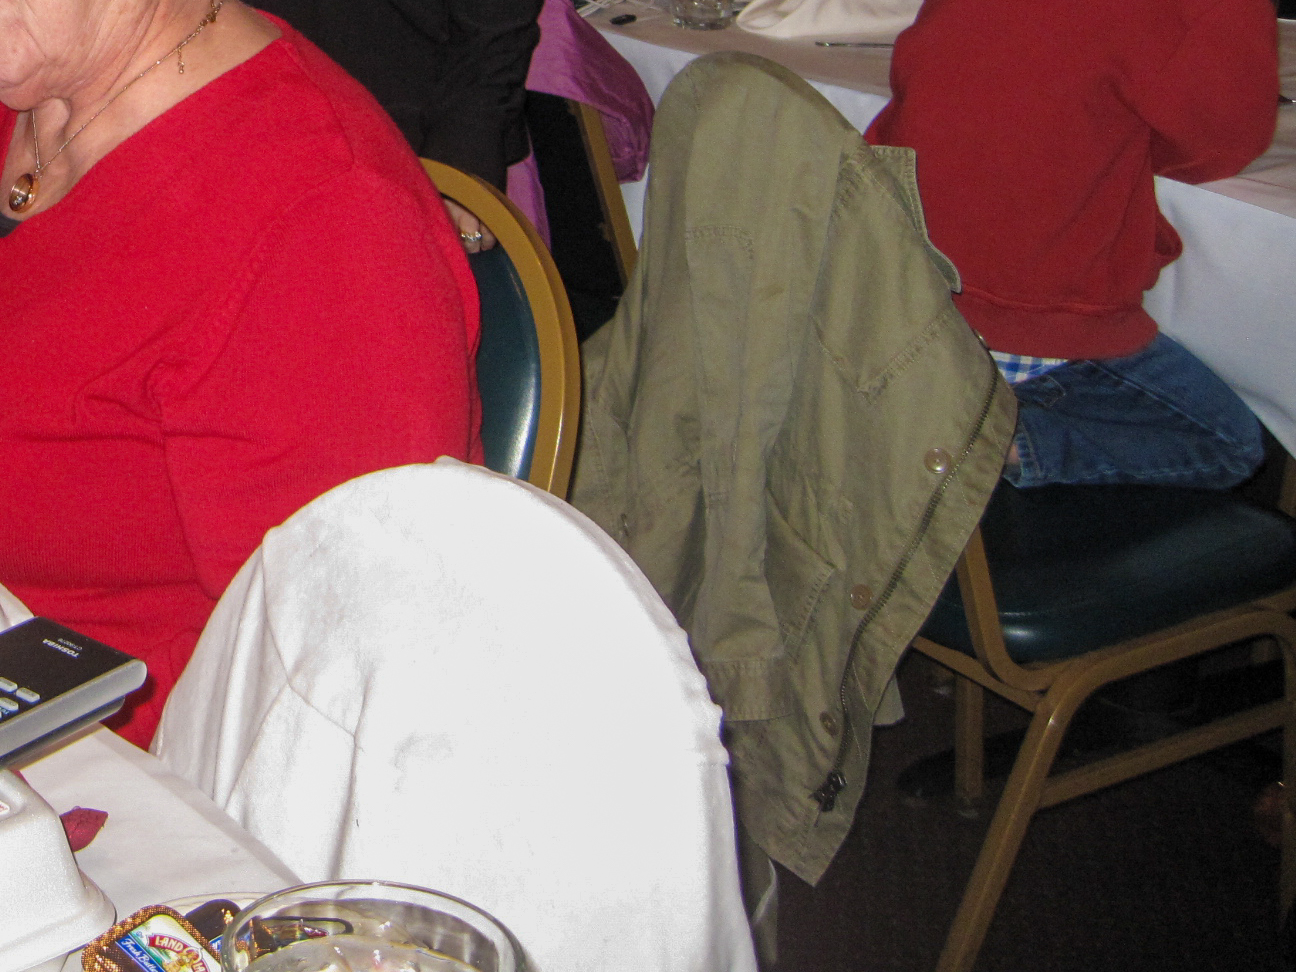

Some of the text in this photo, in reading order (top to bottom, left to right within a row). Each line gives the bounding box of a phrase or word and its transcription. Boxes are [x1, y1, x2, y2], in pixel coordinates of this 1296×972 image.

[42, 638, 80, 658] TOSHIBA
[121, 938, 143, 957] Fresh
[155, 935, 184, 952] LAND
